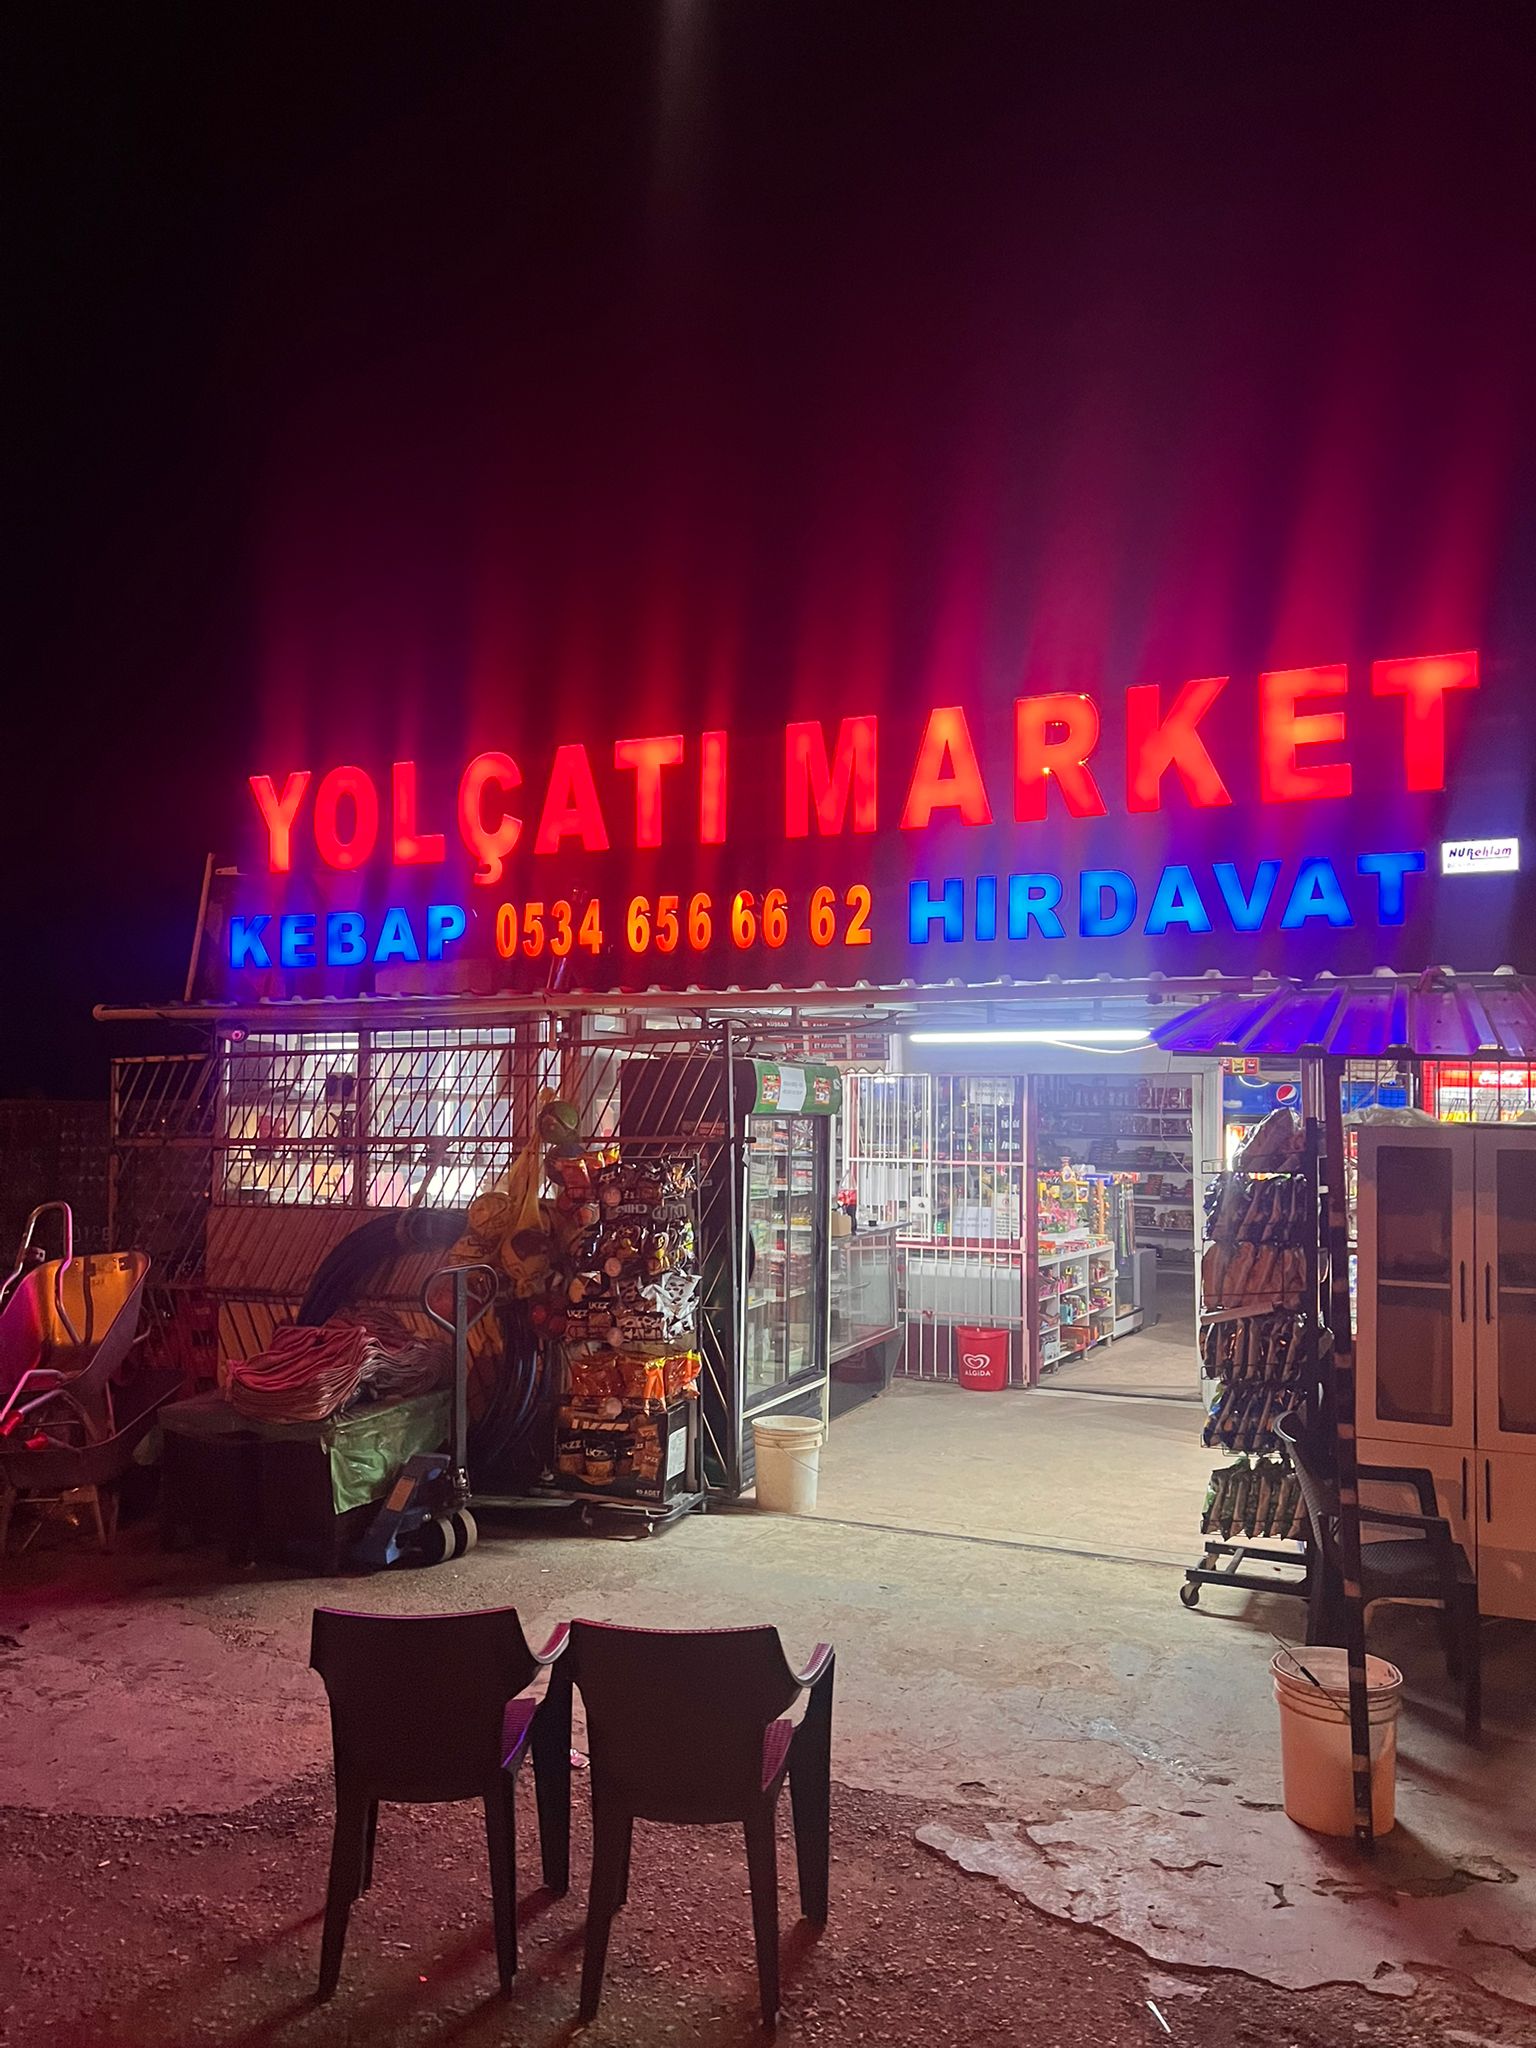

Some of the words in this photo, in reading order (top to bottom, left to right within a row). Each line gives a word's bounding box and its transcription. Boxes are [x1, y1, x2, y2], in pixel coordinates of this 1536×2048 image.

[249, 730, 728, 885] YOLÇATI
[785, 649, 1479, 838] MARKET
[229, 903, 467, 969] KEBAP
[495, 898, 603, 957] 0534
[627, 893, 712, 953] 656
[731, 888, 788, 950] 66
[809, 884, 872, 945] 62
[907, 851, 1427, 945] HIRDAVAT
[965, 1369, 991, 1377] ALGIDA
